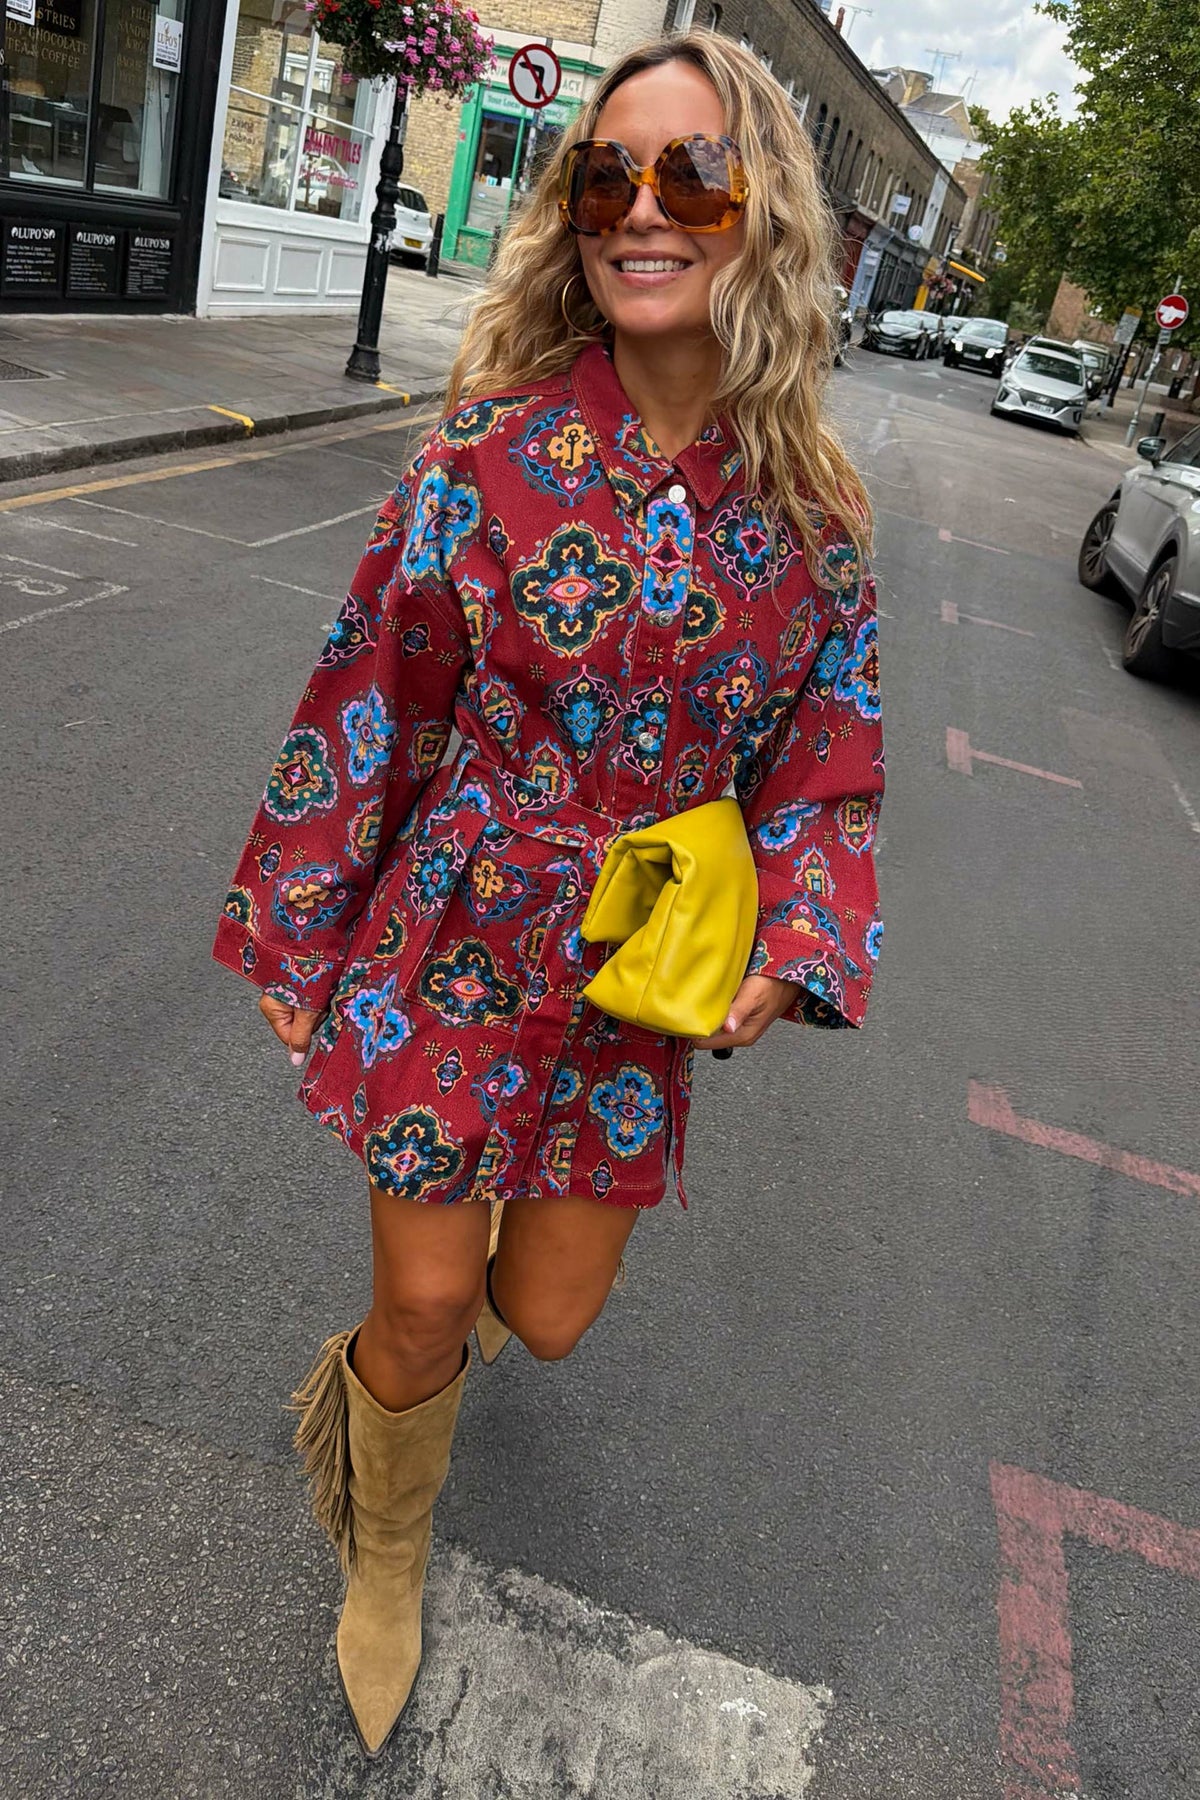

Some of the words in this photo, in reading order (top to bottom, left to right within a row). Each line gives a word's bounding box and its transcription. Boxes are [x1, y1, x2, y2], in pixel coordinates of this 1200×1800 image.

[37, 7, 76, 30] STRIES
[28, 26, 89, 55] CHOCOLATE
[41, 47, 81, 69] COFFEE
[18, 227, 49, 240] LUPO'S
[82, 232, 110, 246] LUPO'S
[140, 237, 165, 249] LUPO'S
